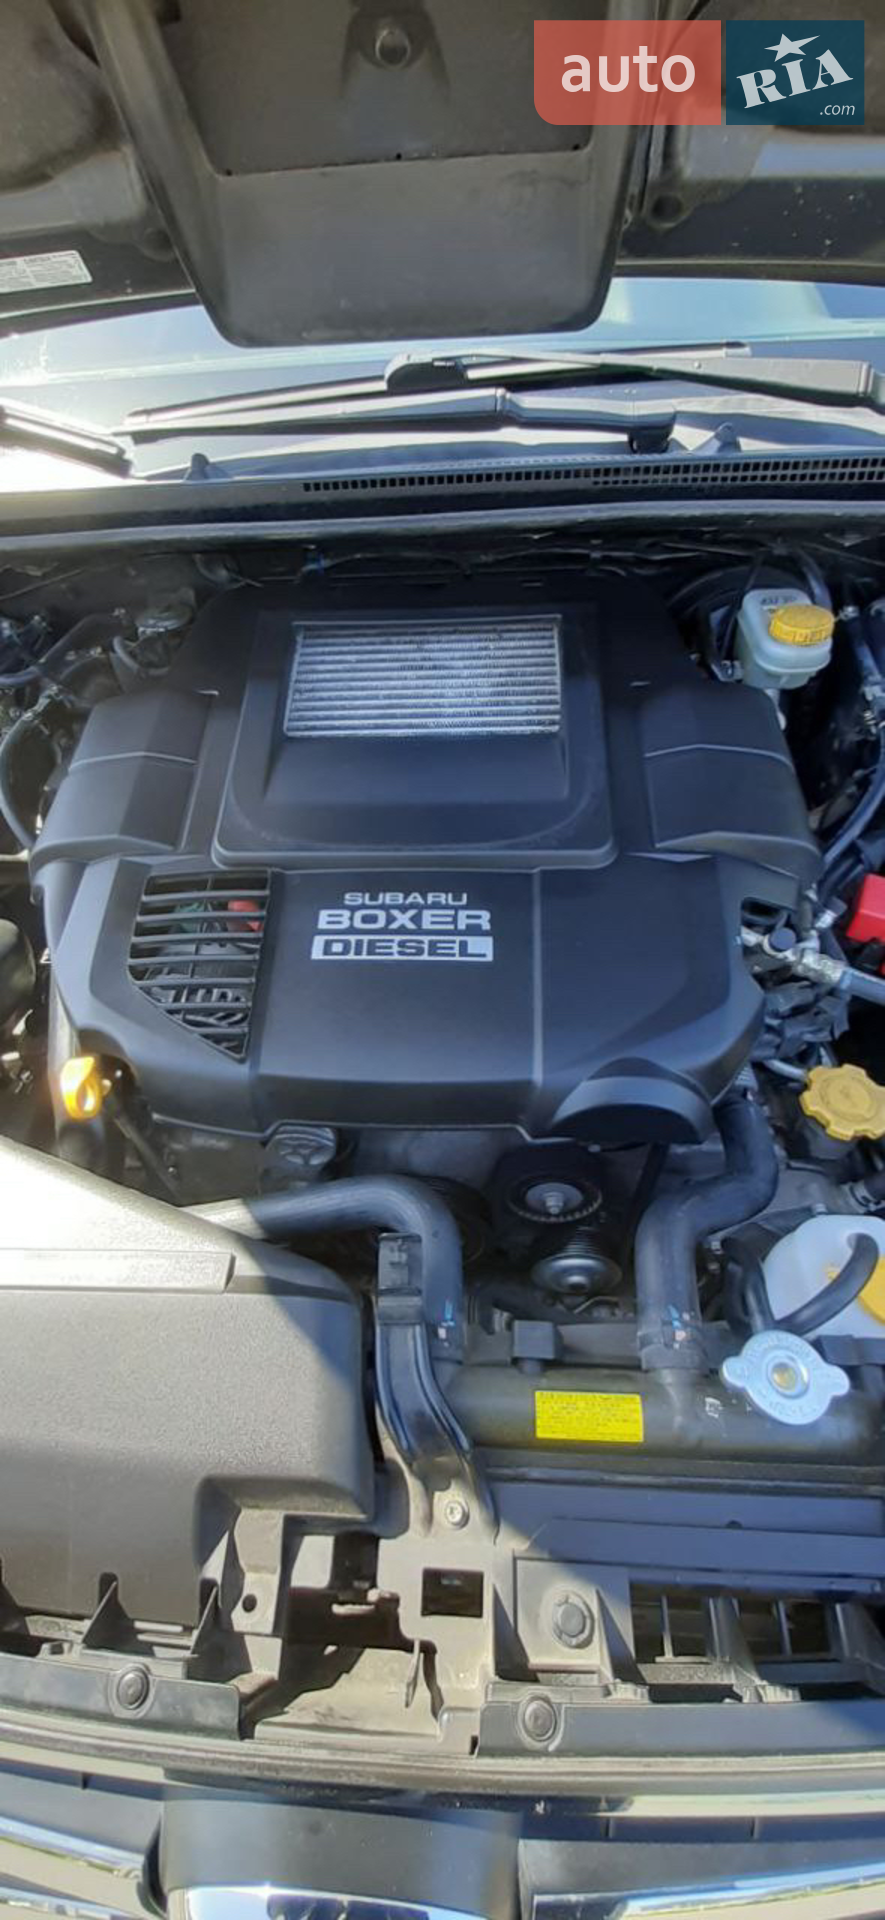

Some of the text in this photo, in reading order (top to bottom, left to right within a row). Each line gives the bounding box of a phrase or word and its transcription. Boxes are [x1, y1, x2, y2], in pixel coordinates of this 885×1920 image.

[344, 892, 467, 905] SUBARU
[317, 909, 491, 930] BOXER
[322, 939, 487, 958] DIESEL
